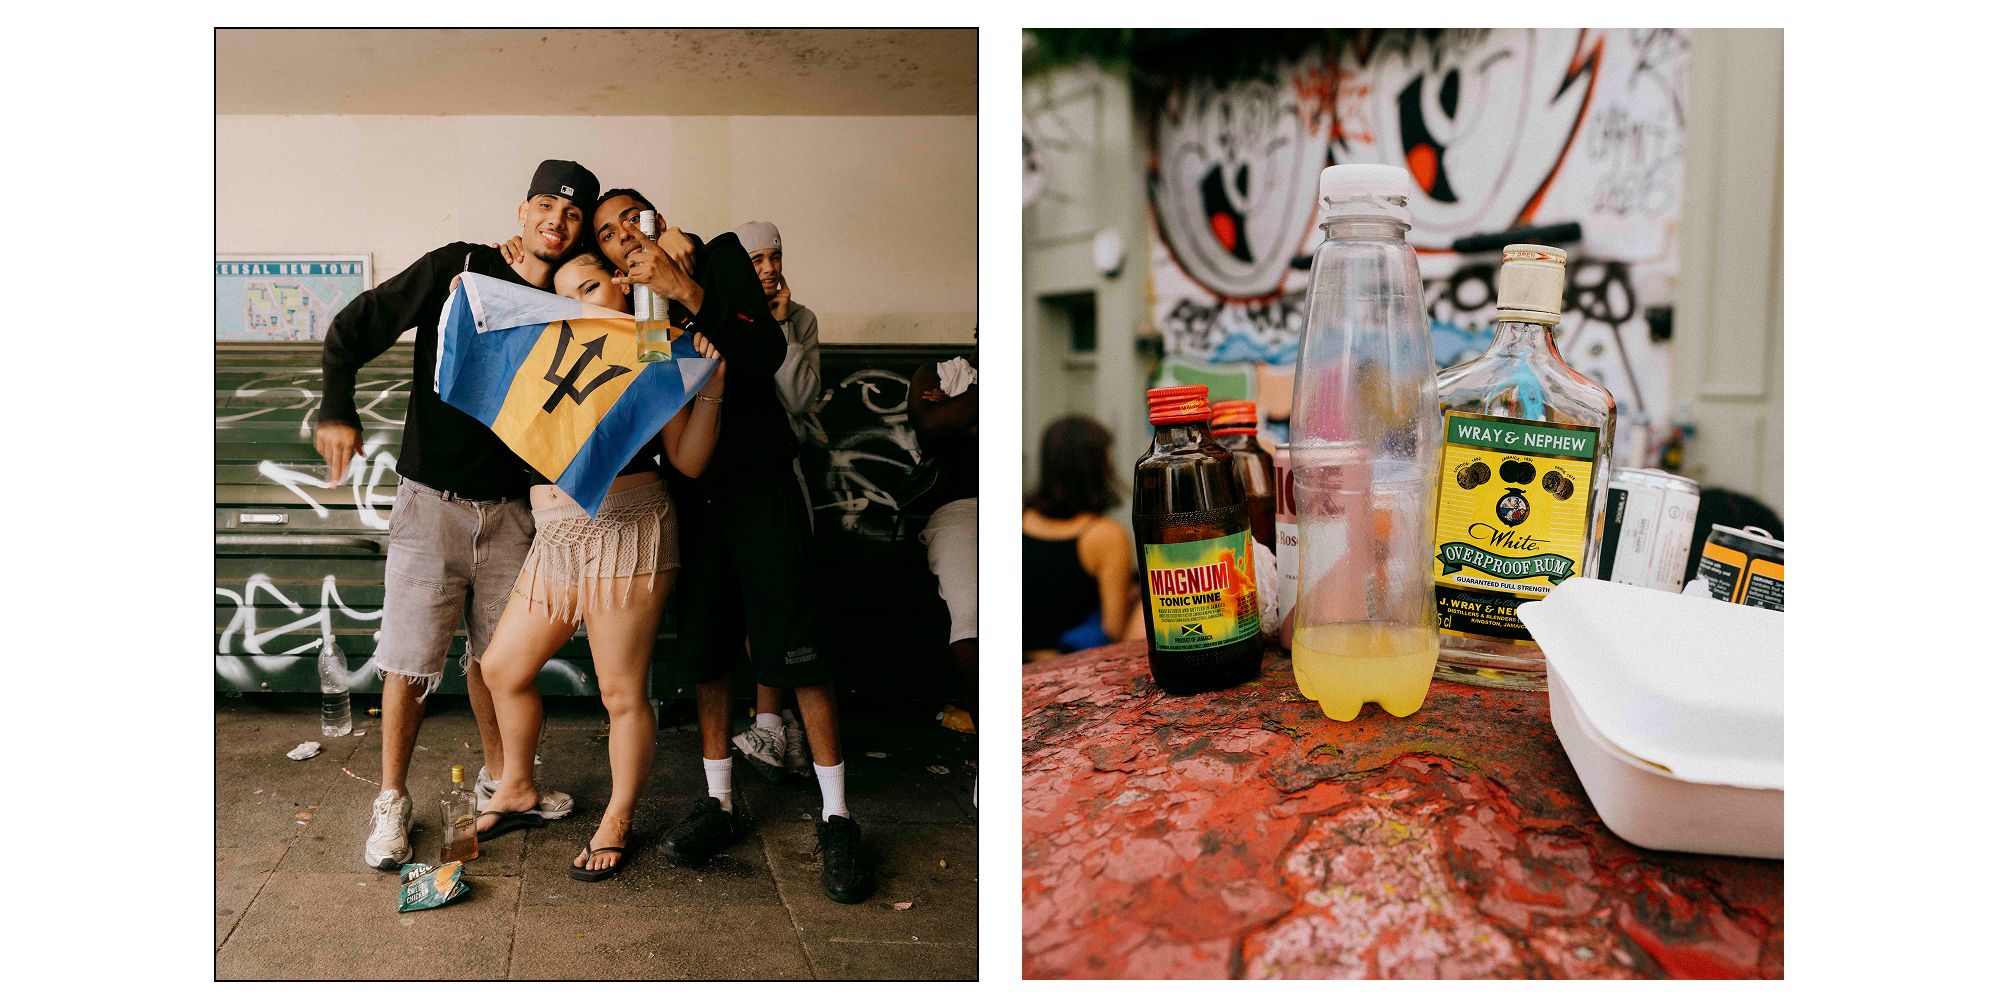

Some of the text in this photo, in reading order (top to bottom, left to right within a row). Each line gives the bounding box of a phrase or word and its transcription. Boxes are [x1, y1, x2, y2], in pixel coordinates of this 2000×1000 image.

[216, 264, 362, 274] ENSAL NEW TOWN
[1458, 424, 1586, 452] WRAY & NEPHEW
[1280, 530, 1298, 546] Ros
[1468, 522, 1550, 550] White
[1446, 546, 1566, 576] OVERPROOF RUM
[1150, 562, 1230, 596] MAGNUM
[1456, 576, 1551, 593] GUARANTEED FULL STRENGTH
[1159, 592, 1221, 607] TONIC WINE
[1440, 598, 1449, 606] J.
[1450, 600, 1481, 612] WRAY
[1447, 608, 1480, 618] DISTILLERS
[1486, 614, 1516, 622] BLENDERS
[1471, 618, 1502, 626] KINGSTON,
